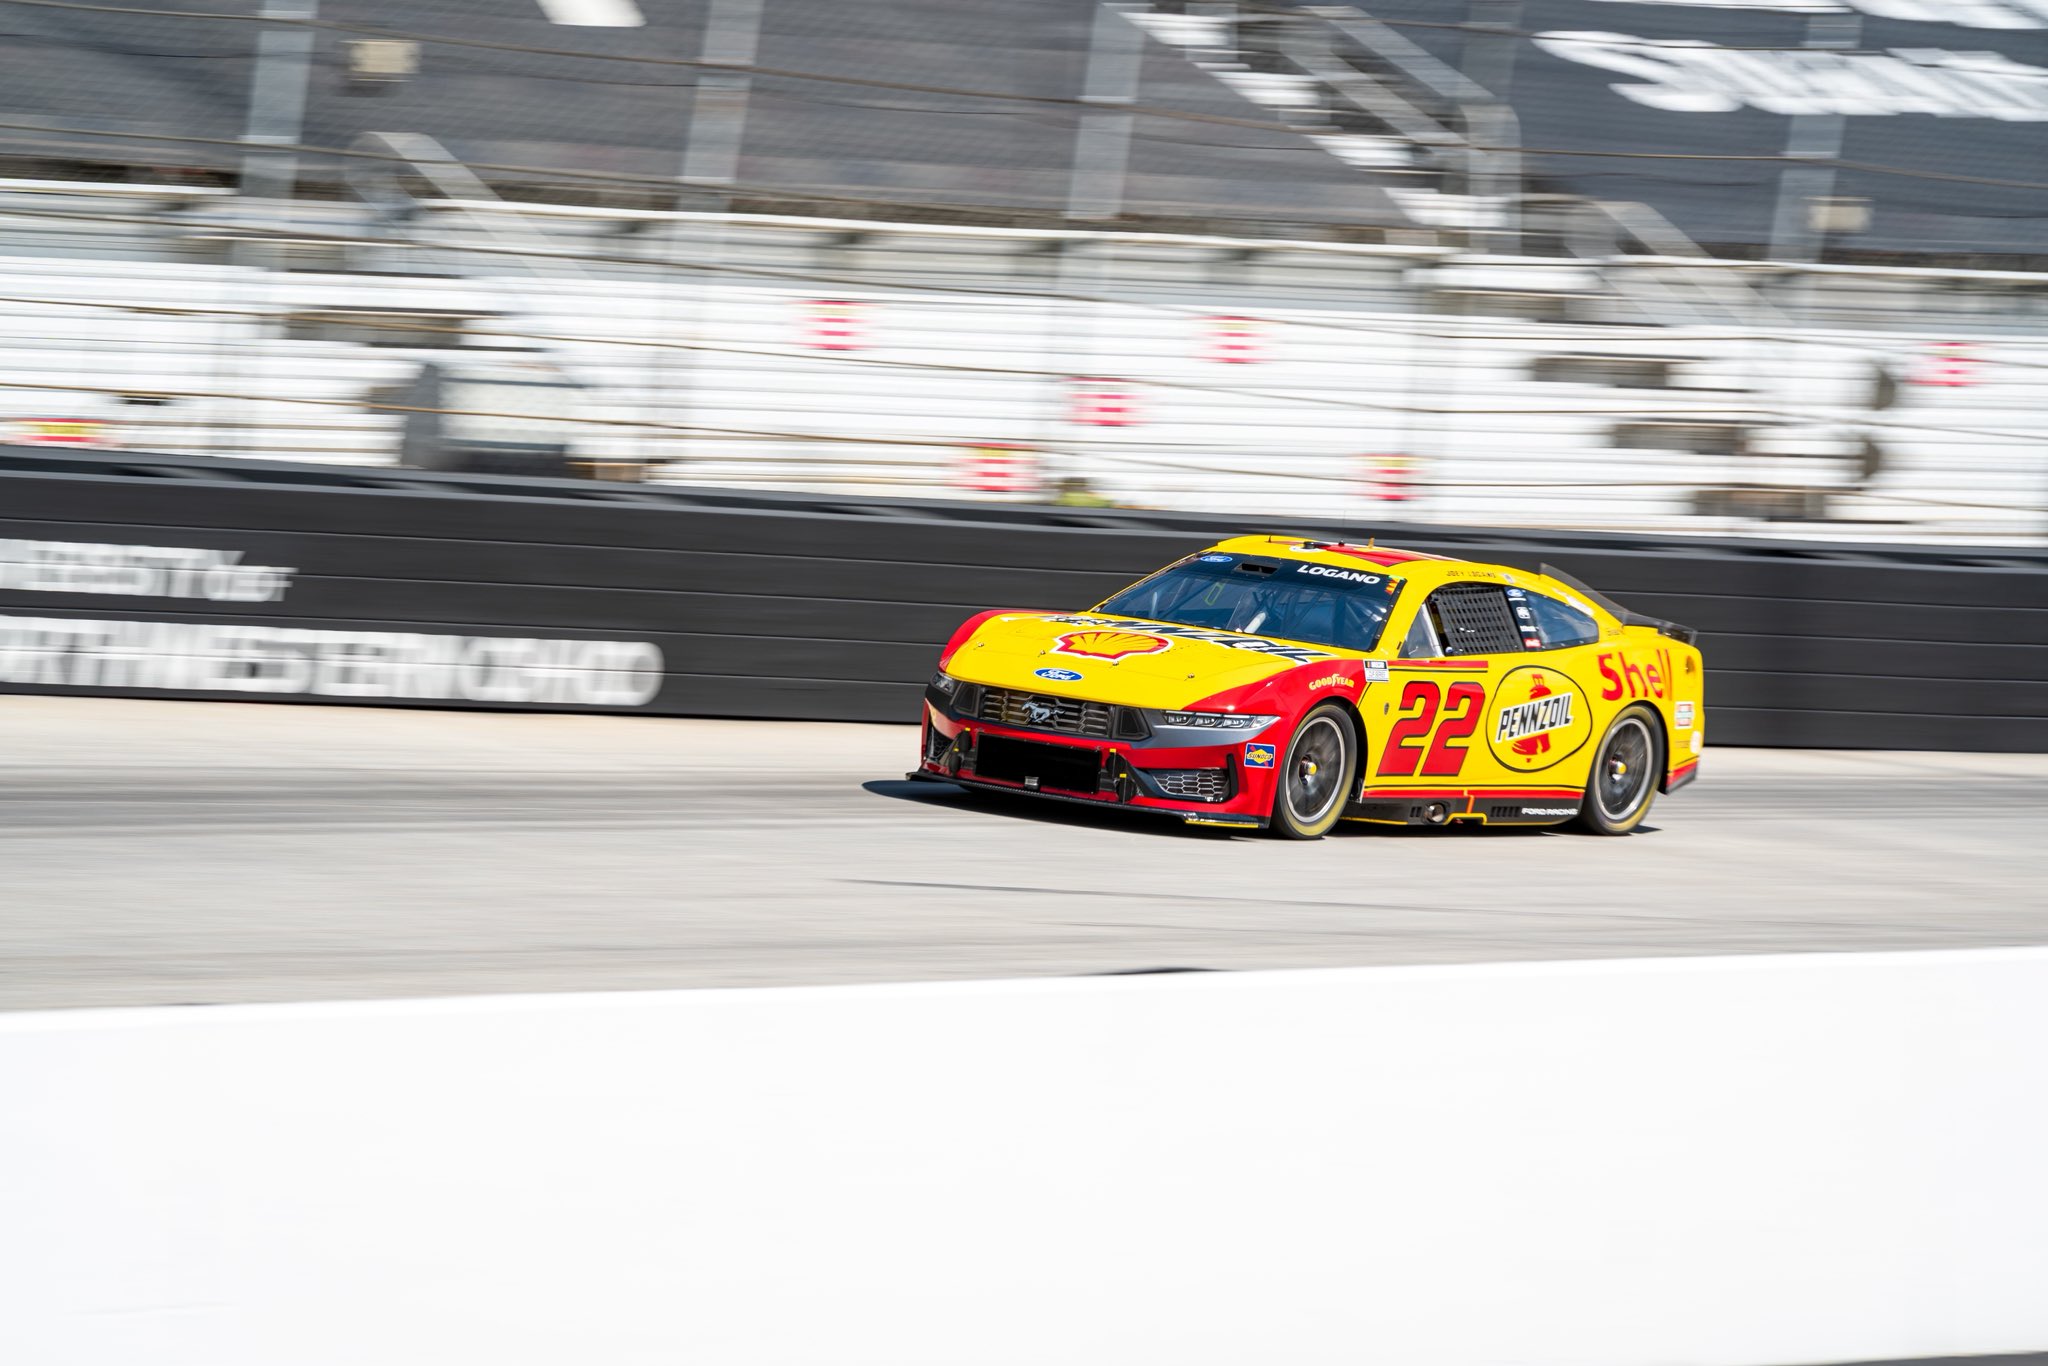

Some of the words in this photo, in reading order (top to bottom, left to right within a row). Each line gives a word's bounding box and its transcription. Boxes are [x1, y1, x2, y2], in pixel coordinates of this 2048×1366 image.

[1297, 564, 1381, 585] LOGANO
[1308, 673, 1355, 690] GOODYEAR
[1597, 649, 1672, 701] Shell
[1375, 680, 1486, 777] 22
[1496, 693, 1572, 742] PENNZOIL
[1247, 752, 1274, 760] SUNOCO
